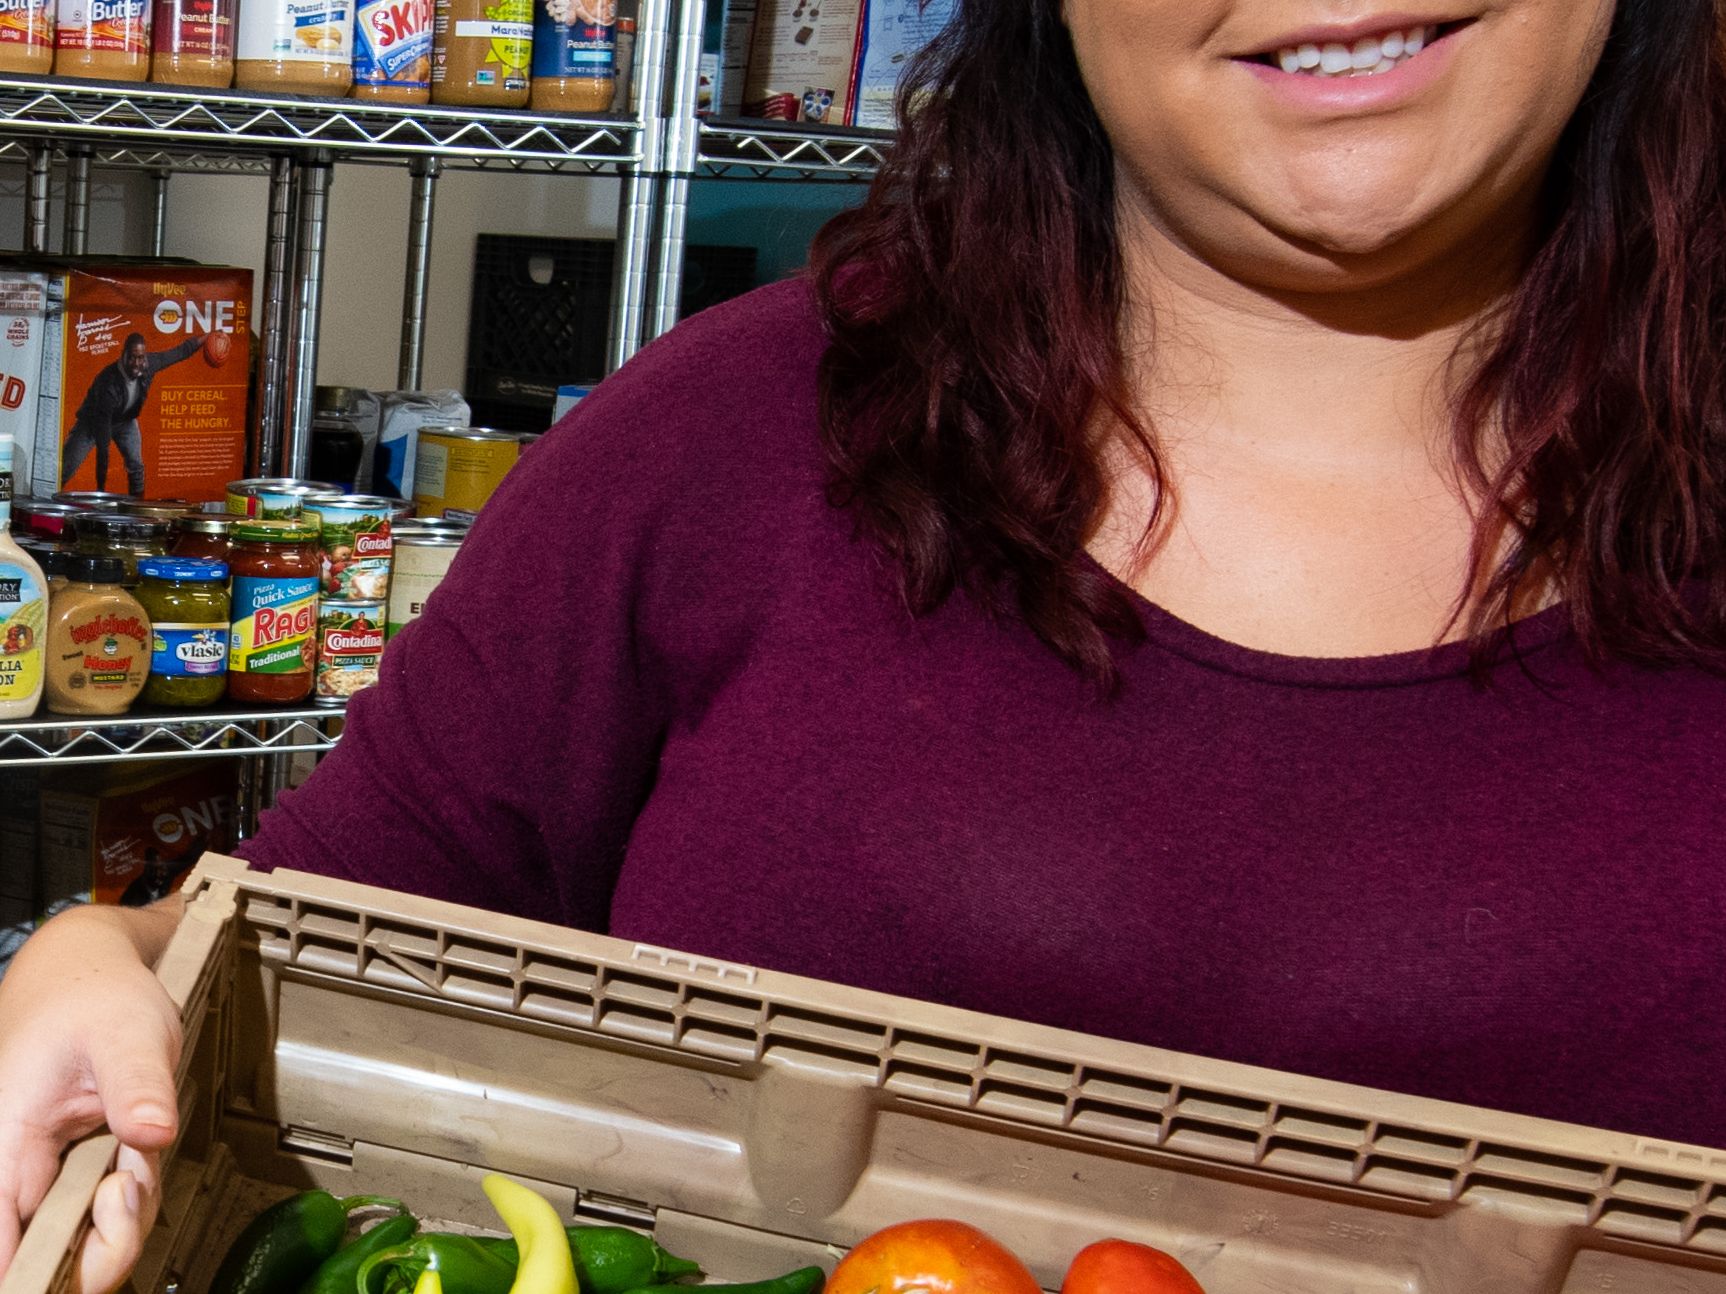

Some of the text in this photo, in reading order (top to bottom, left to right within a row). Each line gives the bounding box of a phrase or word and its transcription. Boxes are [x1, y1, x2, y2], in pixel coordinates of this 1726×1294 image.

[91, 0, 145, 21] Butter
[153, 300, 236, 335] ONE
[235, 300, 247, 335] STEP
[161, 403, 217, 417] HELP FEED
[160, 416, 232, 431] THE HUNGRY.
[252, 581, 313, 608] Quick Sauce
[253, 583, 275, 596] Pizza
[326, 632, 382, 650] Contadina
[180, 642, 224, 659] vlasic
[249, 645, 301, 669] Traditional
[83, 654, 133, 671] Honey
